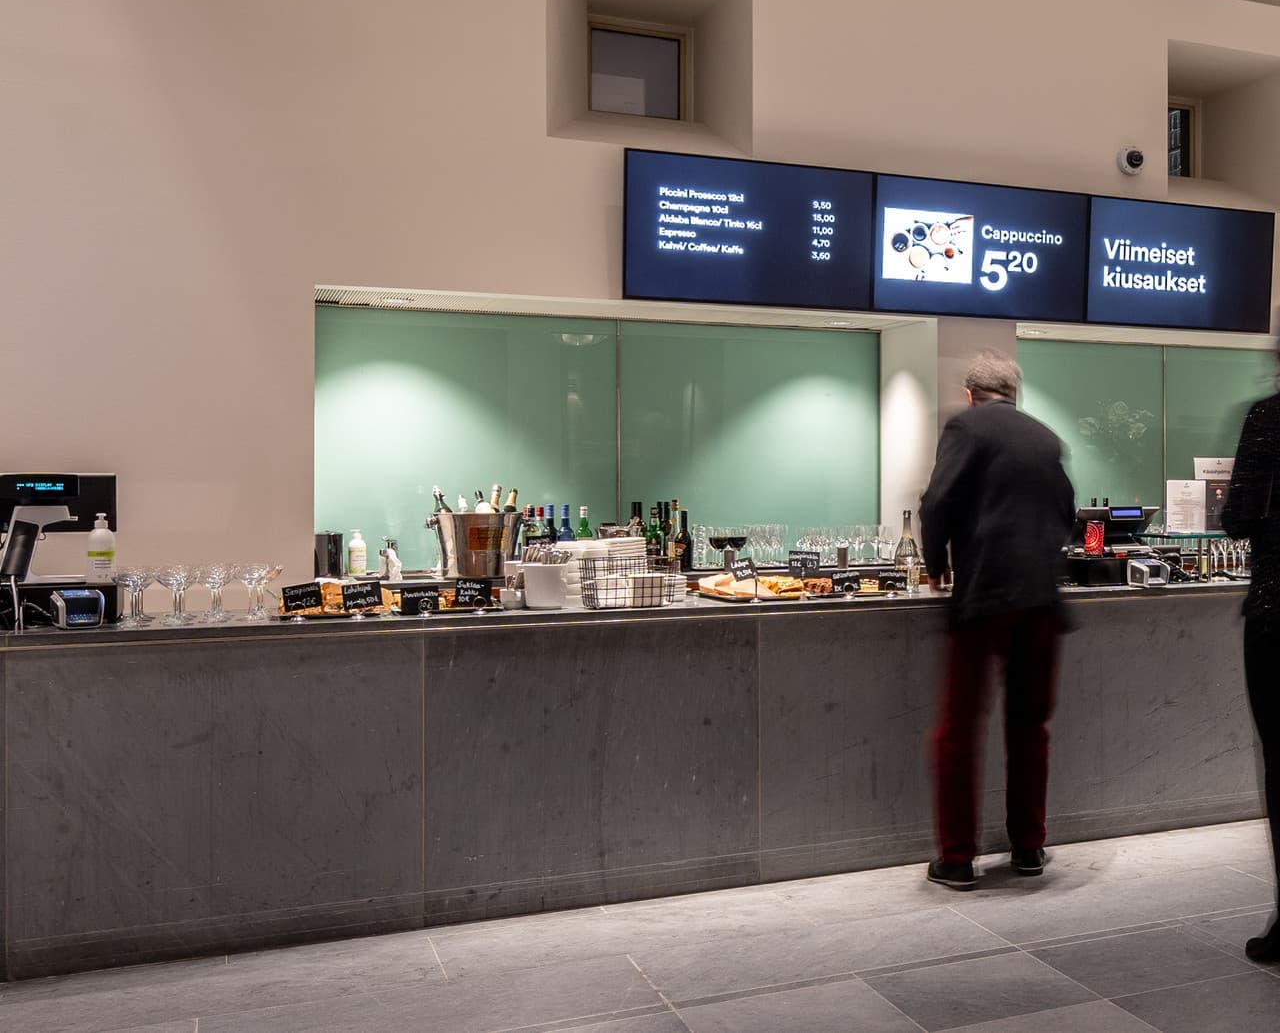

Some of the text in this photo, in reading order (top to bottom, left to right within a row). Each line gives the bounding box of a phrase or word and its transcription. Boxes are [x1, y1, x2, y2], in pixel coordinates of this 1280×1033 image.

[659, 186, 688, 198] Piccini
[689, 189, 727, 201] Prosecco
[659, 200, 729, 214] Champagne 10cl
[812, 200, 832, 210] 9,50
[812, 213, 836, 223] 15,00
[723, 219, 745, 229] Tinto
[658, 227, 697, 238] Espresso
[812, 226, 833, 236] 11,00
[981, 225, 1063, 245] Cappuccino
[811, 238, 831, 248] 4,70
[811, 251, 831, 261] 3,60
[1103, 237, 1195, 266] Viimeiset
[1102, 266, 1206, 294] kiusaukset
